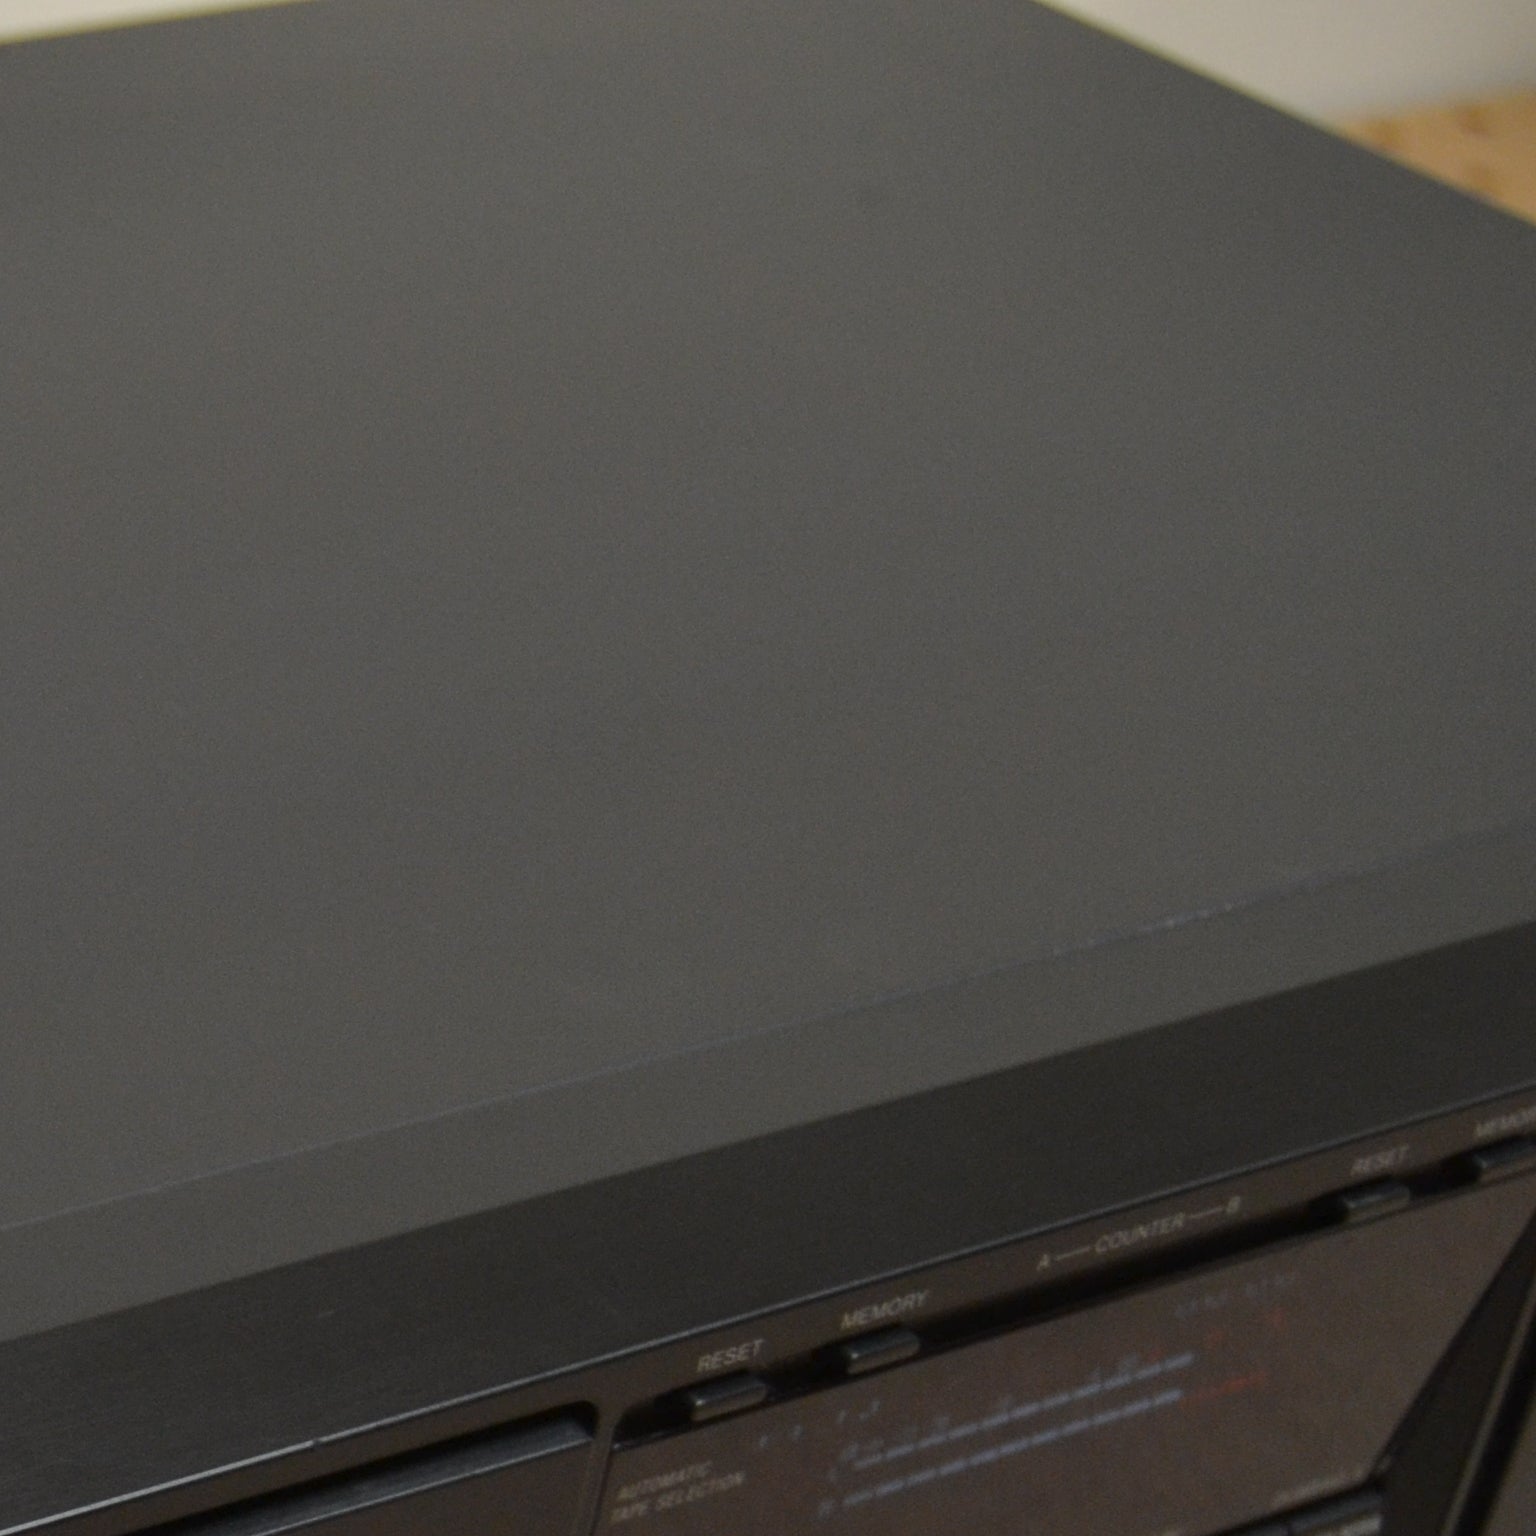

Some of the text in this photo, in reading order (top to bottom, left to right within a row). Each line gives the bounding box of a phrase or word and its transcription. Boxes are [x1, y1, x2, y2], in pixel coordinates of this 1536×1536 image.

[1349, 1144, 1411, 1177] RESET
[1035, 1253, 1051, 1272] A
[1093, 1209, 1187, 1255] COUNTER
[839, 1288, 932, 1331] MEMORY
[695, 1338, 767, 1374] RESET
